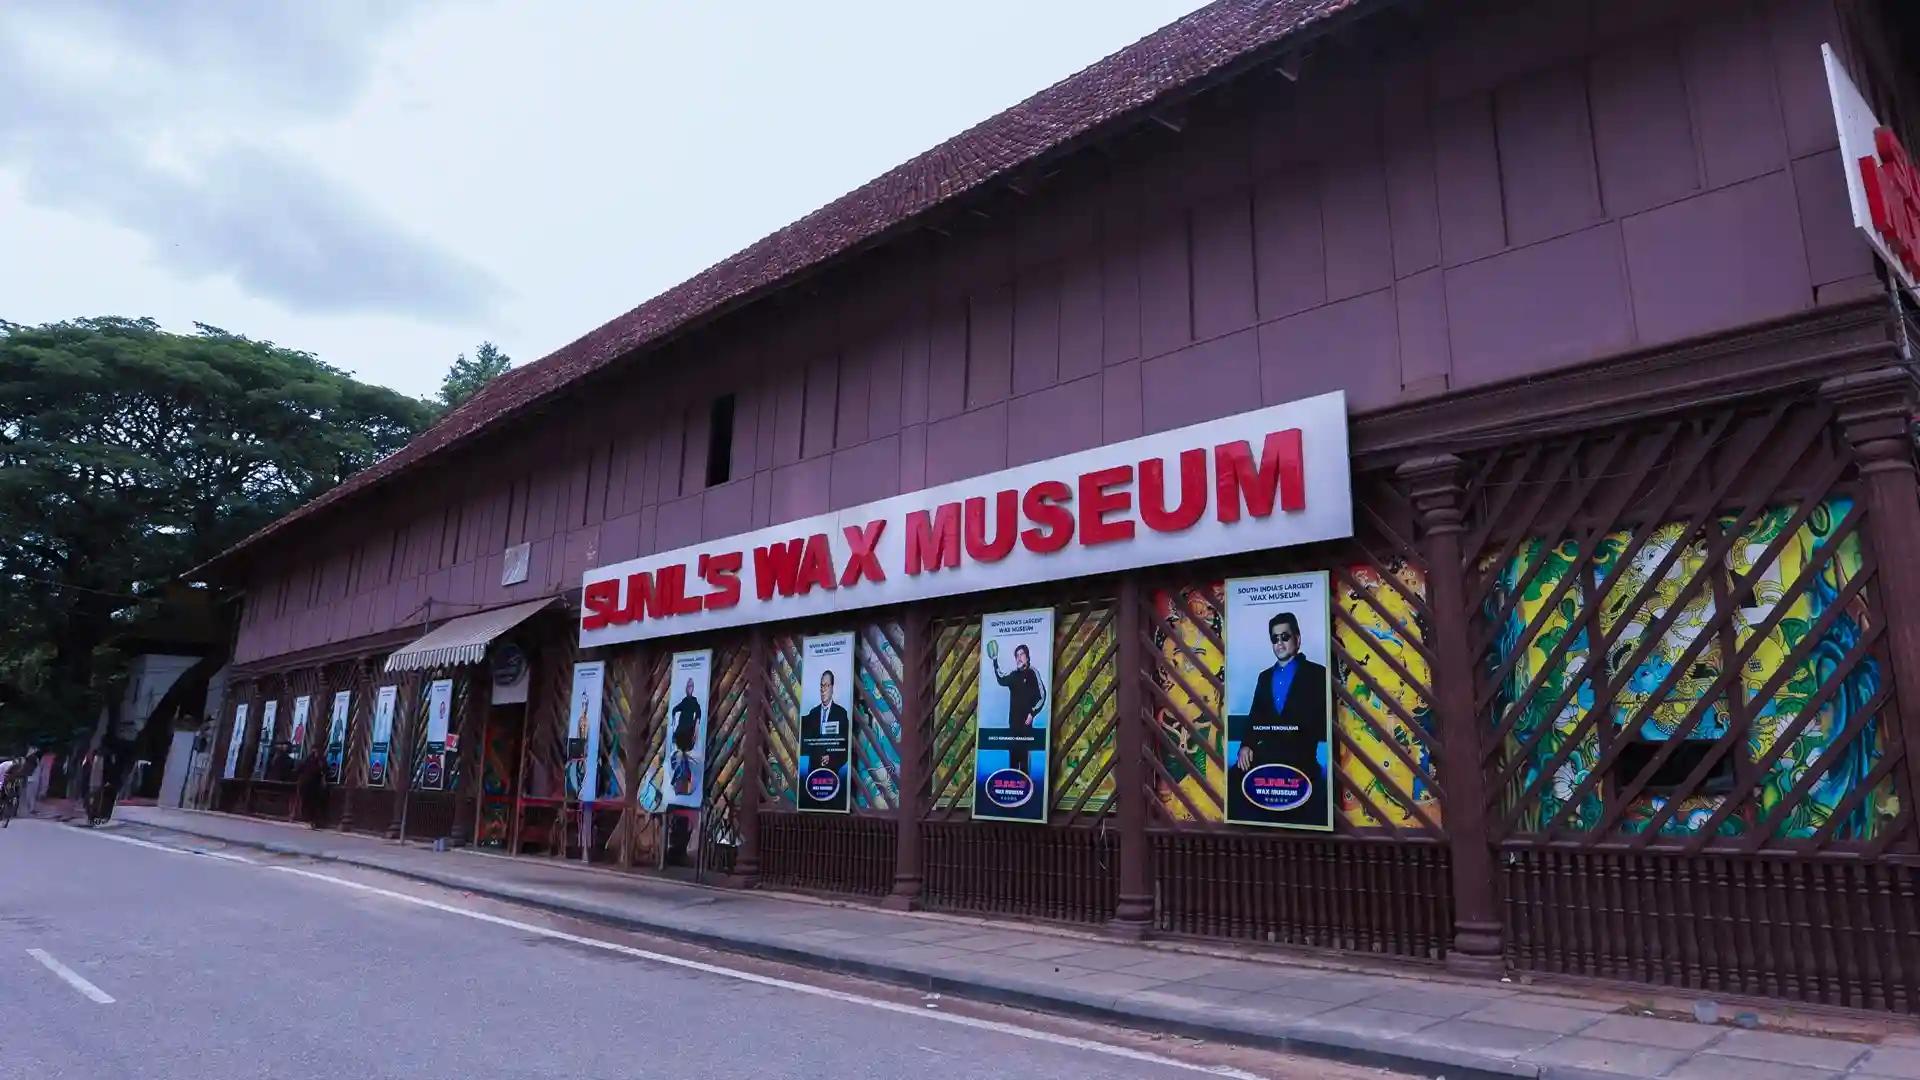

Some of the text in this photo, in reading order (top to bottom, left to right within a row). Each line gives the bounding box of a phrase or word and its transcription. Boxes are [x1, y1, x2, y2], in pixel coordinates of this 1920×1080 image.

[583, 551, 743, 631] SUNIL'S
[753, 518, 887, 601] WAX
[904, 428, 1306, 576] MUSEUM
[1237, 582, 1313, 595] SOUTH INDIA'S LARGEST
[1268, 591, 1301, 600] MUSEUM
